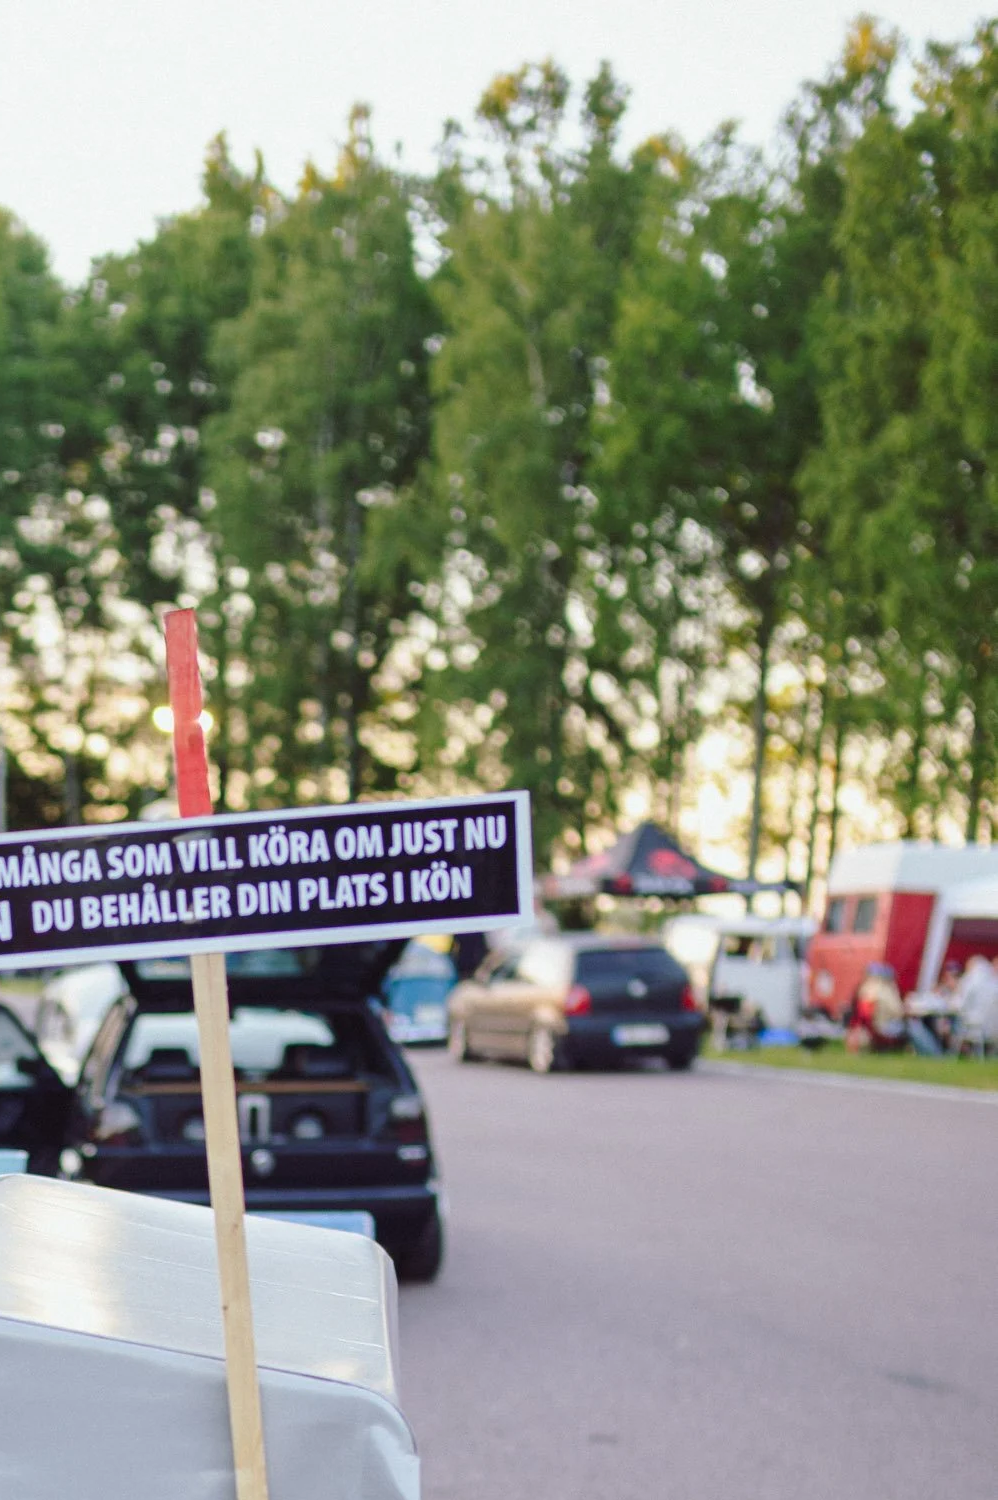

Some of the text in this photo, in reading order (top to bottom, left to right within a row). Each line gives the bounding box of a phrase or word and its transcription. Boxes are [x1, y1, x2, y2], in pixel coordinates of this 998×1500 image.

[106, 842, 173, 879] SOM
[177, 836, 243, 873] VILL
[248, 825, 330, 868] KÖRA
[334, 825, 384, 860] OM
[388, 819, 458, 856] JUST
[464, 815, 506, 850] NU
[32, 898, 74, 934] DU
[80, 883, 231, 929] BEHÅLLER
[237, 880, 291, 917] DIN
[298, 872, 388, 912] PLATS
[393, 871, 405, 904] I
[410, 861, 473, 903] KÖN
